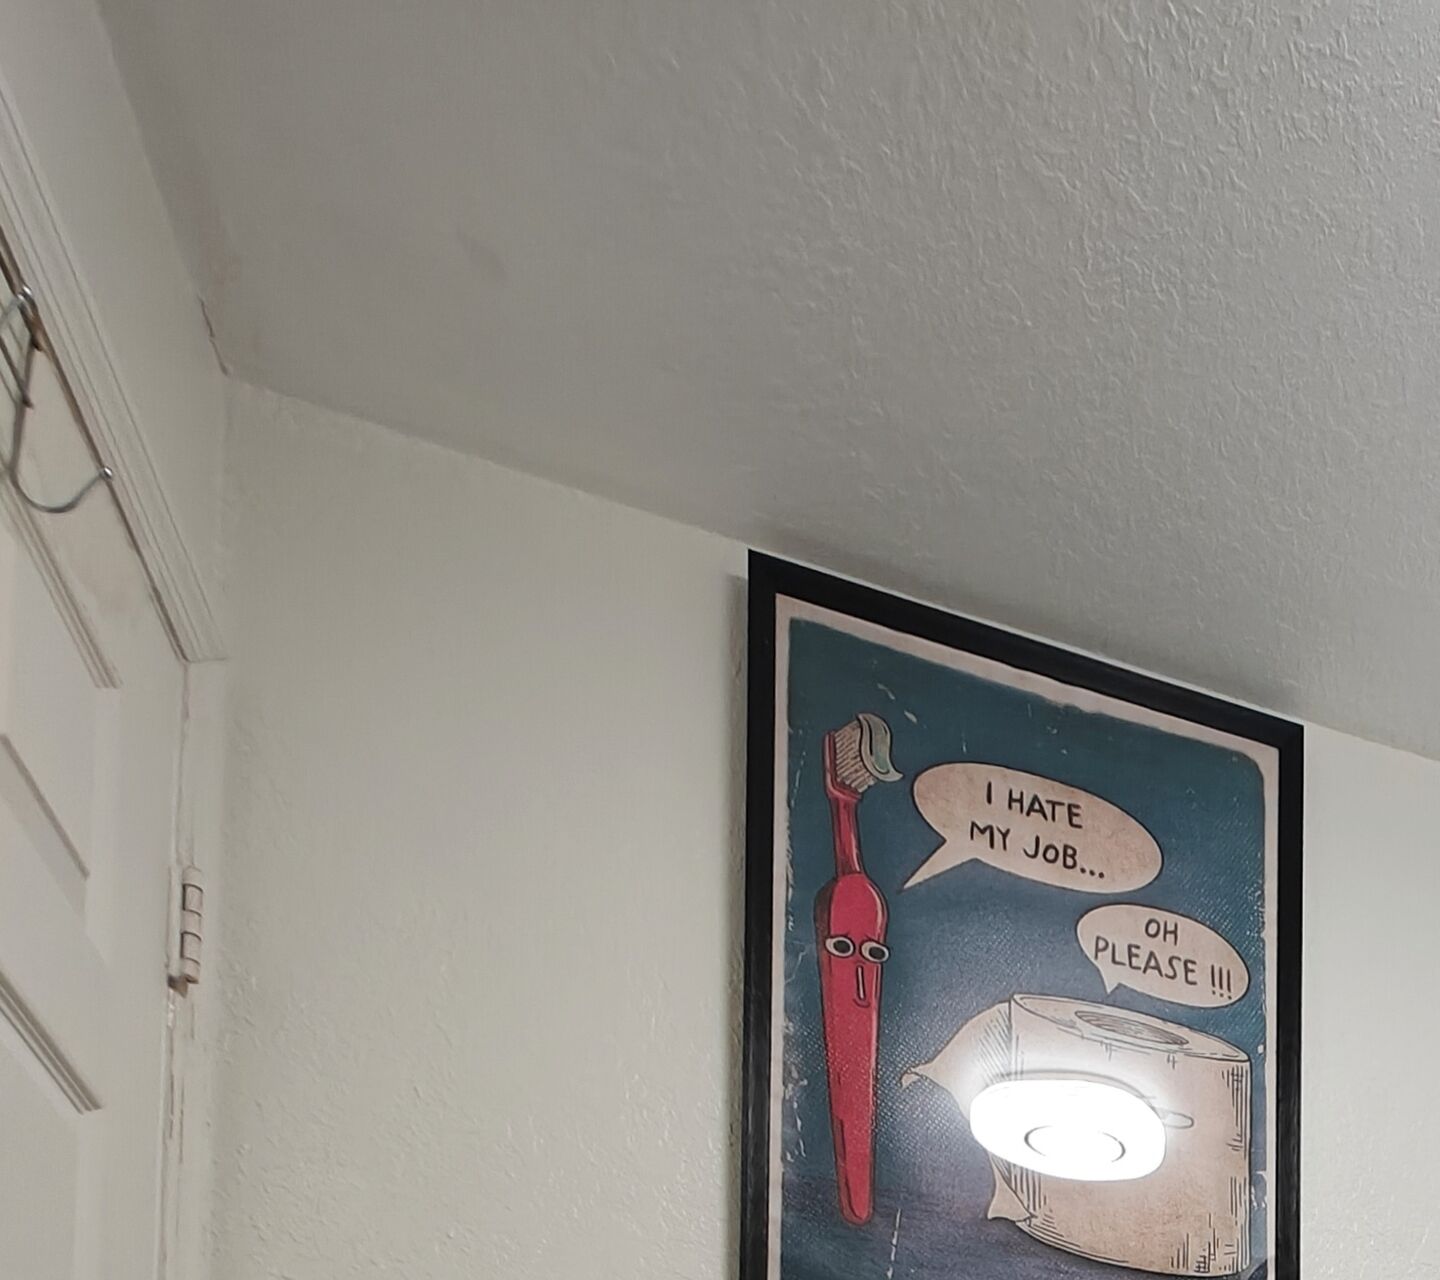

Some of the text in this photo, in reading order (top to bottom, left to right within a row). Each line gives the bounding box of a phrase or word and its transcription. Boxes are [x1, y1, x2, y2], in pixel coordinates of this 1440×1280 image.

[986, 781, 1083, 829] I HATE
[970, 820, 1105, 879] MY JOB...
[1144, 918, 1179, 946] OH
[1094, 935, 1198, 986] PLEASE
